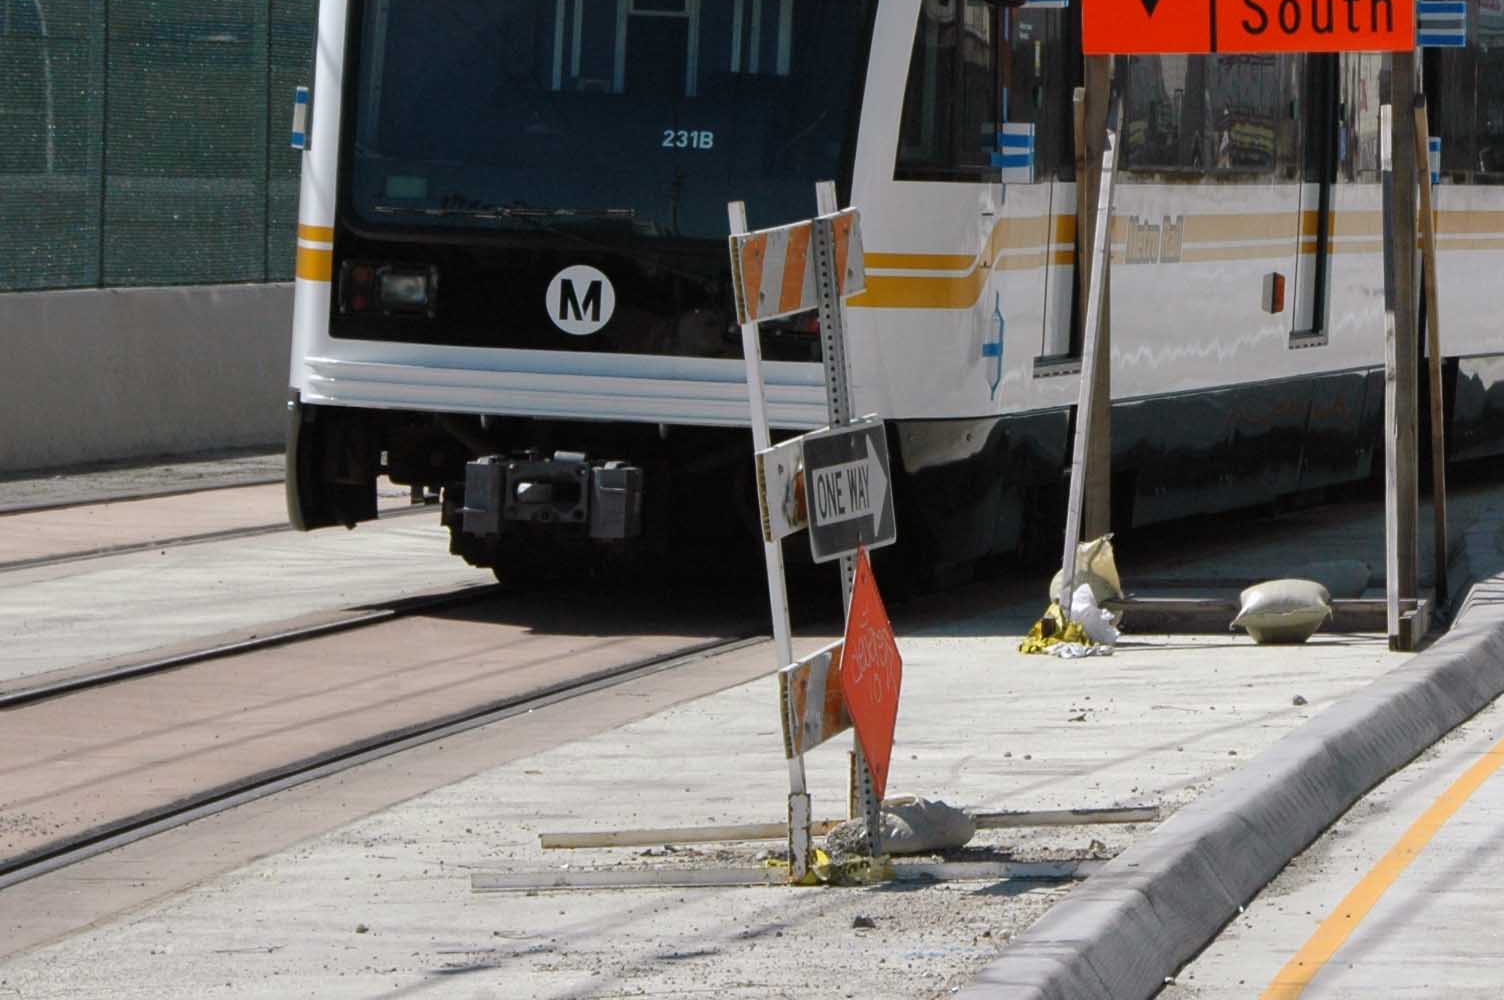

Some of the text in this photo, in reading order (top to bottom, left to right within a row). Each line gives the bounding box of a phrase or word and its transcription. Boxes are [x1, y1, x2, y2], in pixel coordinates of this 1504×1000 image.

[661, 129, 715, 149] 231B
[558, 278, 602, 322] M
[816, 462, 871, 520] ONE WAY
